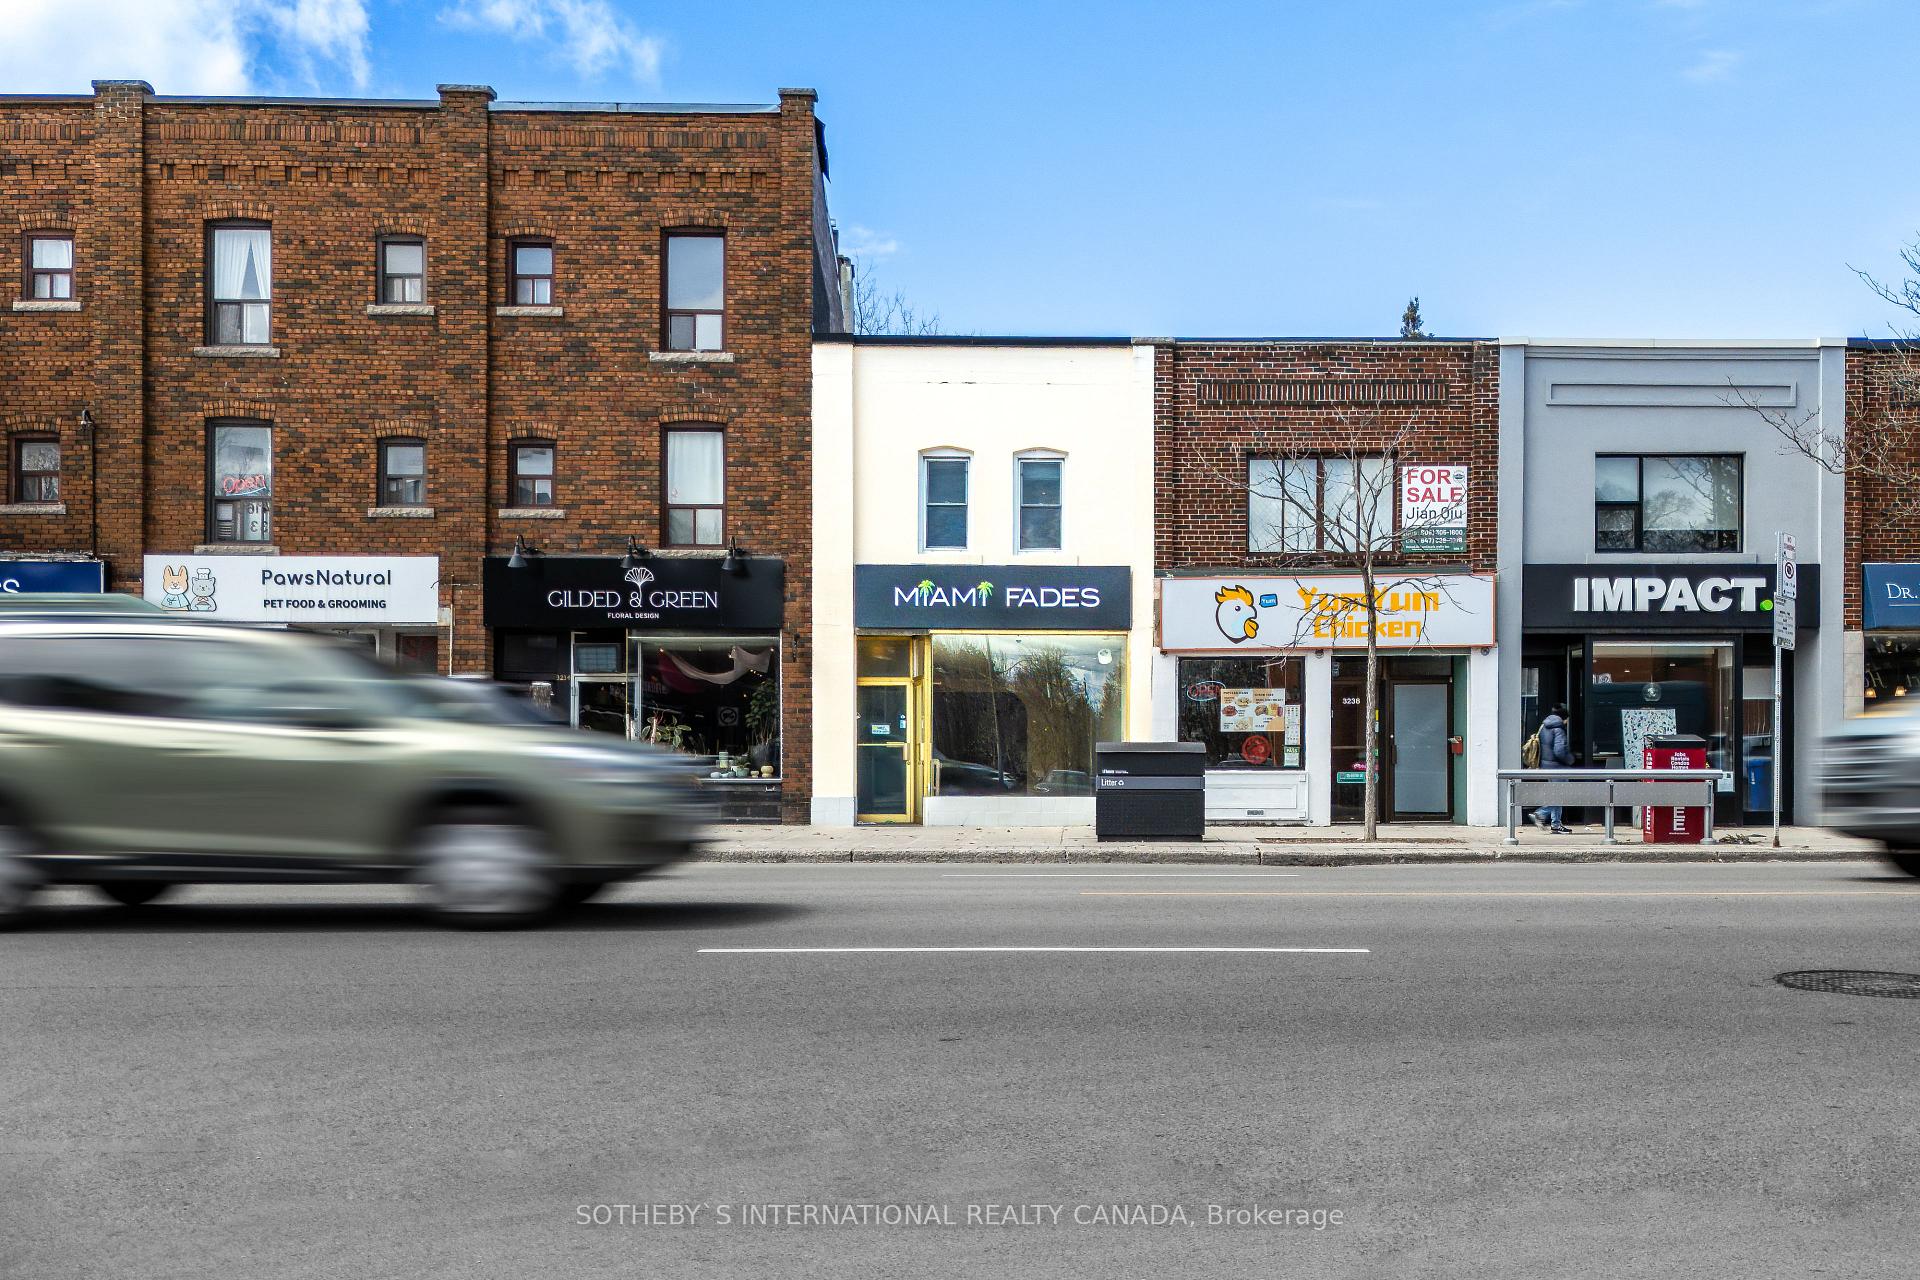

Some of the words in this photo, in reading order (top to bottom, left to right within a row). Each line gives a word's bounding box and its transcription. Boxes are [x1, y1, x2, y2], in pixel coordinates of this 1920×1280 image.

[223, 474, 266, 493] Open
[1407, 469, 1451, 485] FOR
[1407, 487, 1464, 503] SALE
[1406, 507, 1437, 520] Jian
[261, 569, 391, 586] PawsNatural
[547, 590, 621, 608] GILDED
[629, 591, 643, 608] &
[649, 591, 718, 608] GREEN
[894, 579, 993, 607] MIAMI
[1006, 587, 1100, 608] FADES
[263, 599, 284, 609] PET
[285, 599, 315, 609] FOOD
[317, 599, 326, 609] &
[328, 599, 387, 609] GROOMING
[1313, 615, 1422, 639] Chicken
[1101, 778, 1117, 787] Litter
